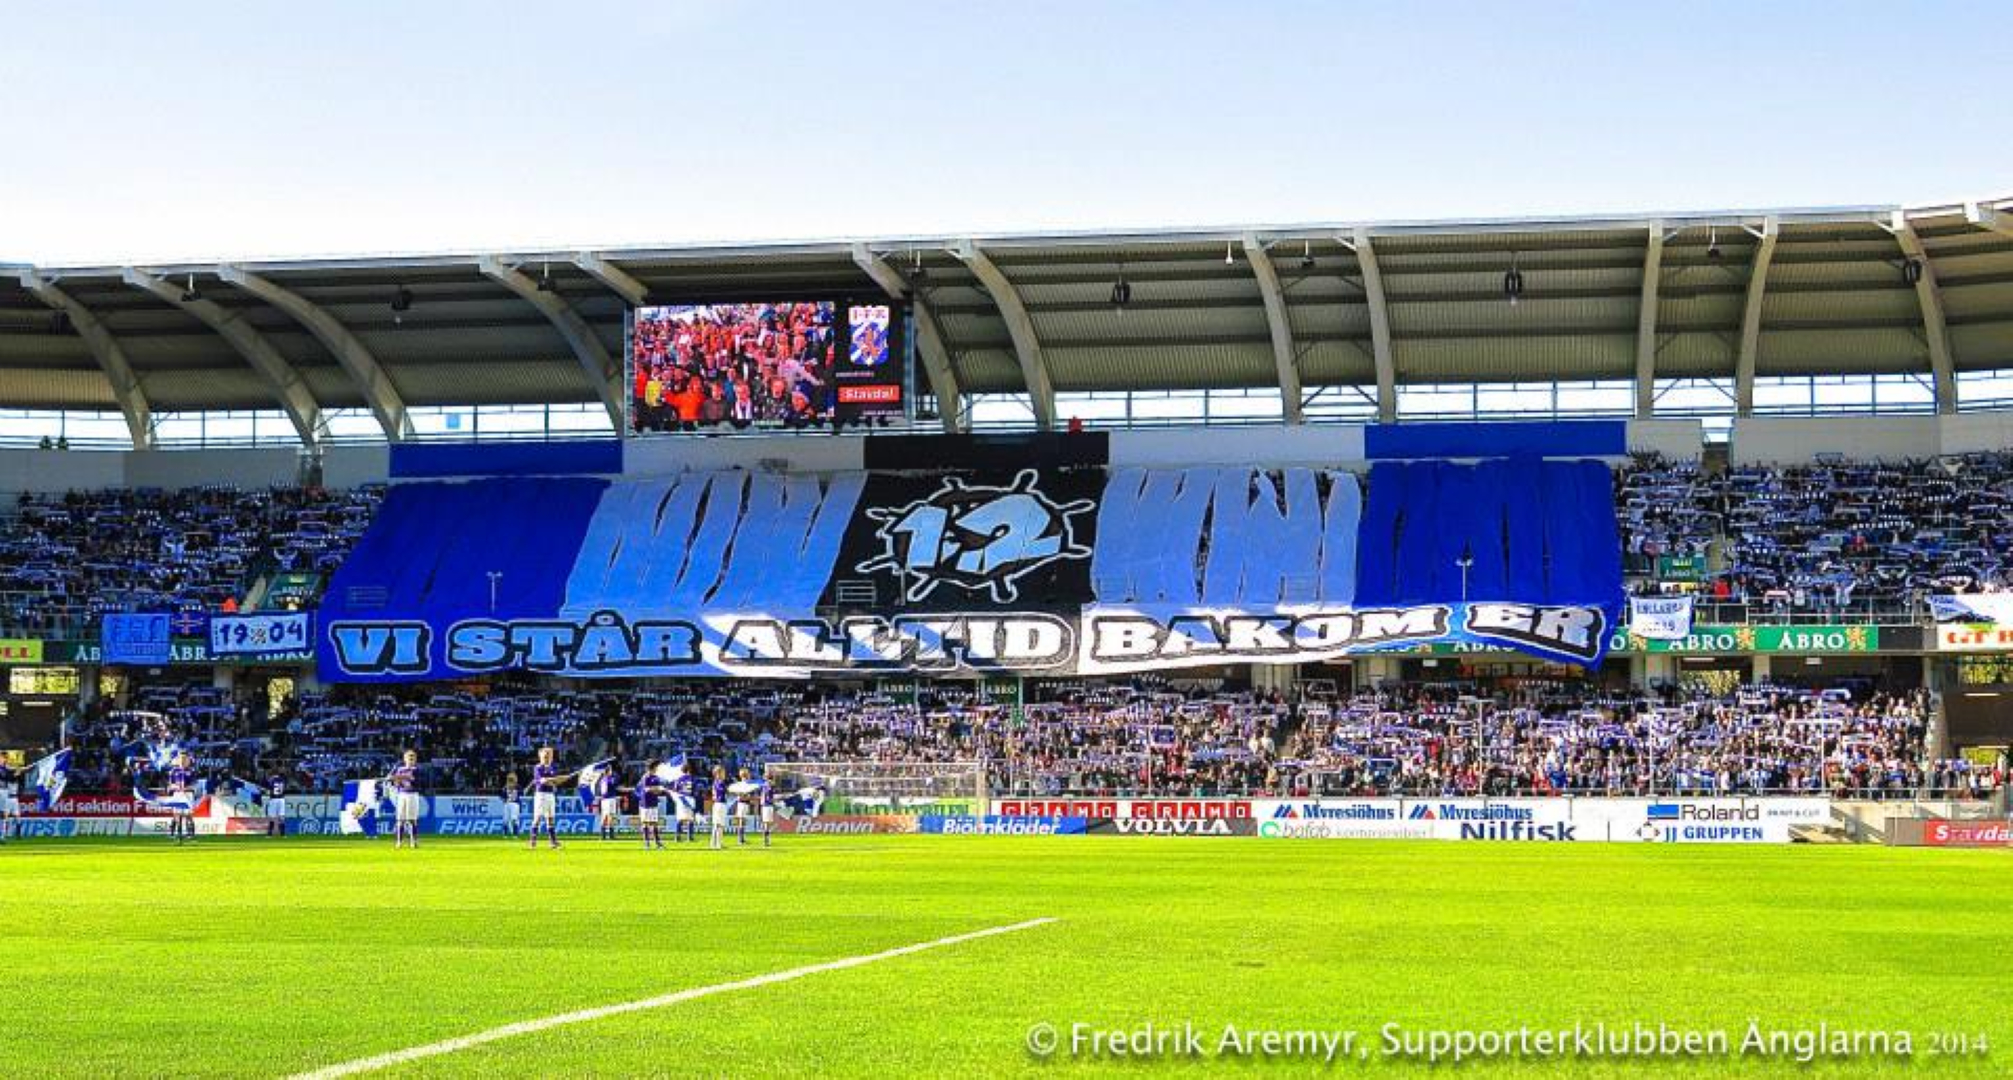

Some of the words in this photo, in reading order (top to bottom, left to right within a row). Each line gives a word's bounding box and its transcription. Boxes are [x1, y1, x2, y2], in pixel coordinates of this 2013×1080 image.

[332, 620, 430, 673] VI
[447, 610, 703, 672] STÅR
[718, 613, 1078, 669] ALLTID
[1090, 605, 1450, 662] BAKOM
[1464, 602, 1605, 662] ER
[452, 803, 489, 814] WHC
[1114, 818, 1233, 834] VOLVIA
[1461, 820, 1577, 841] Nilfisk
[1684, 824, 1764, 840] GRUPPEN
